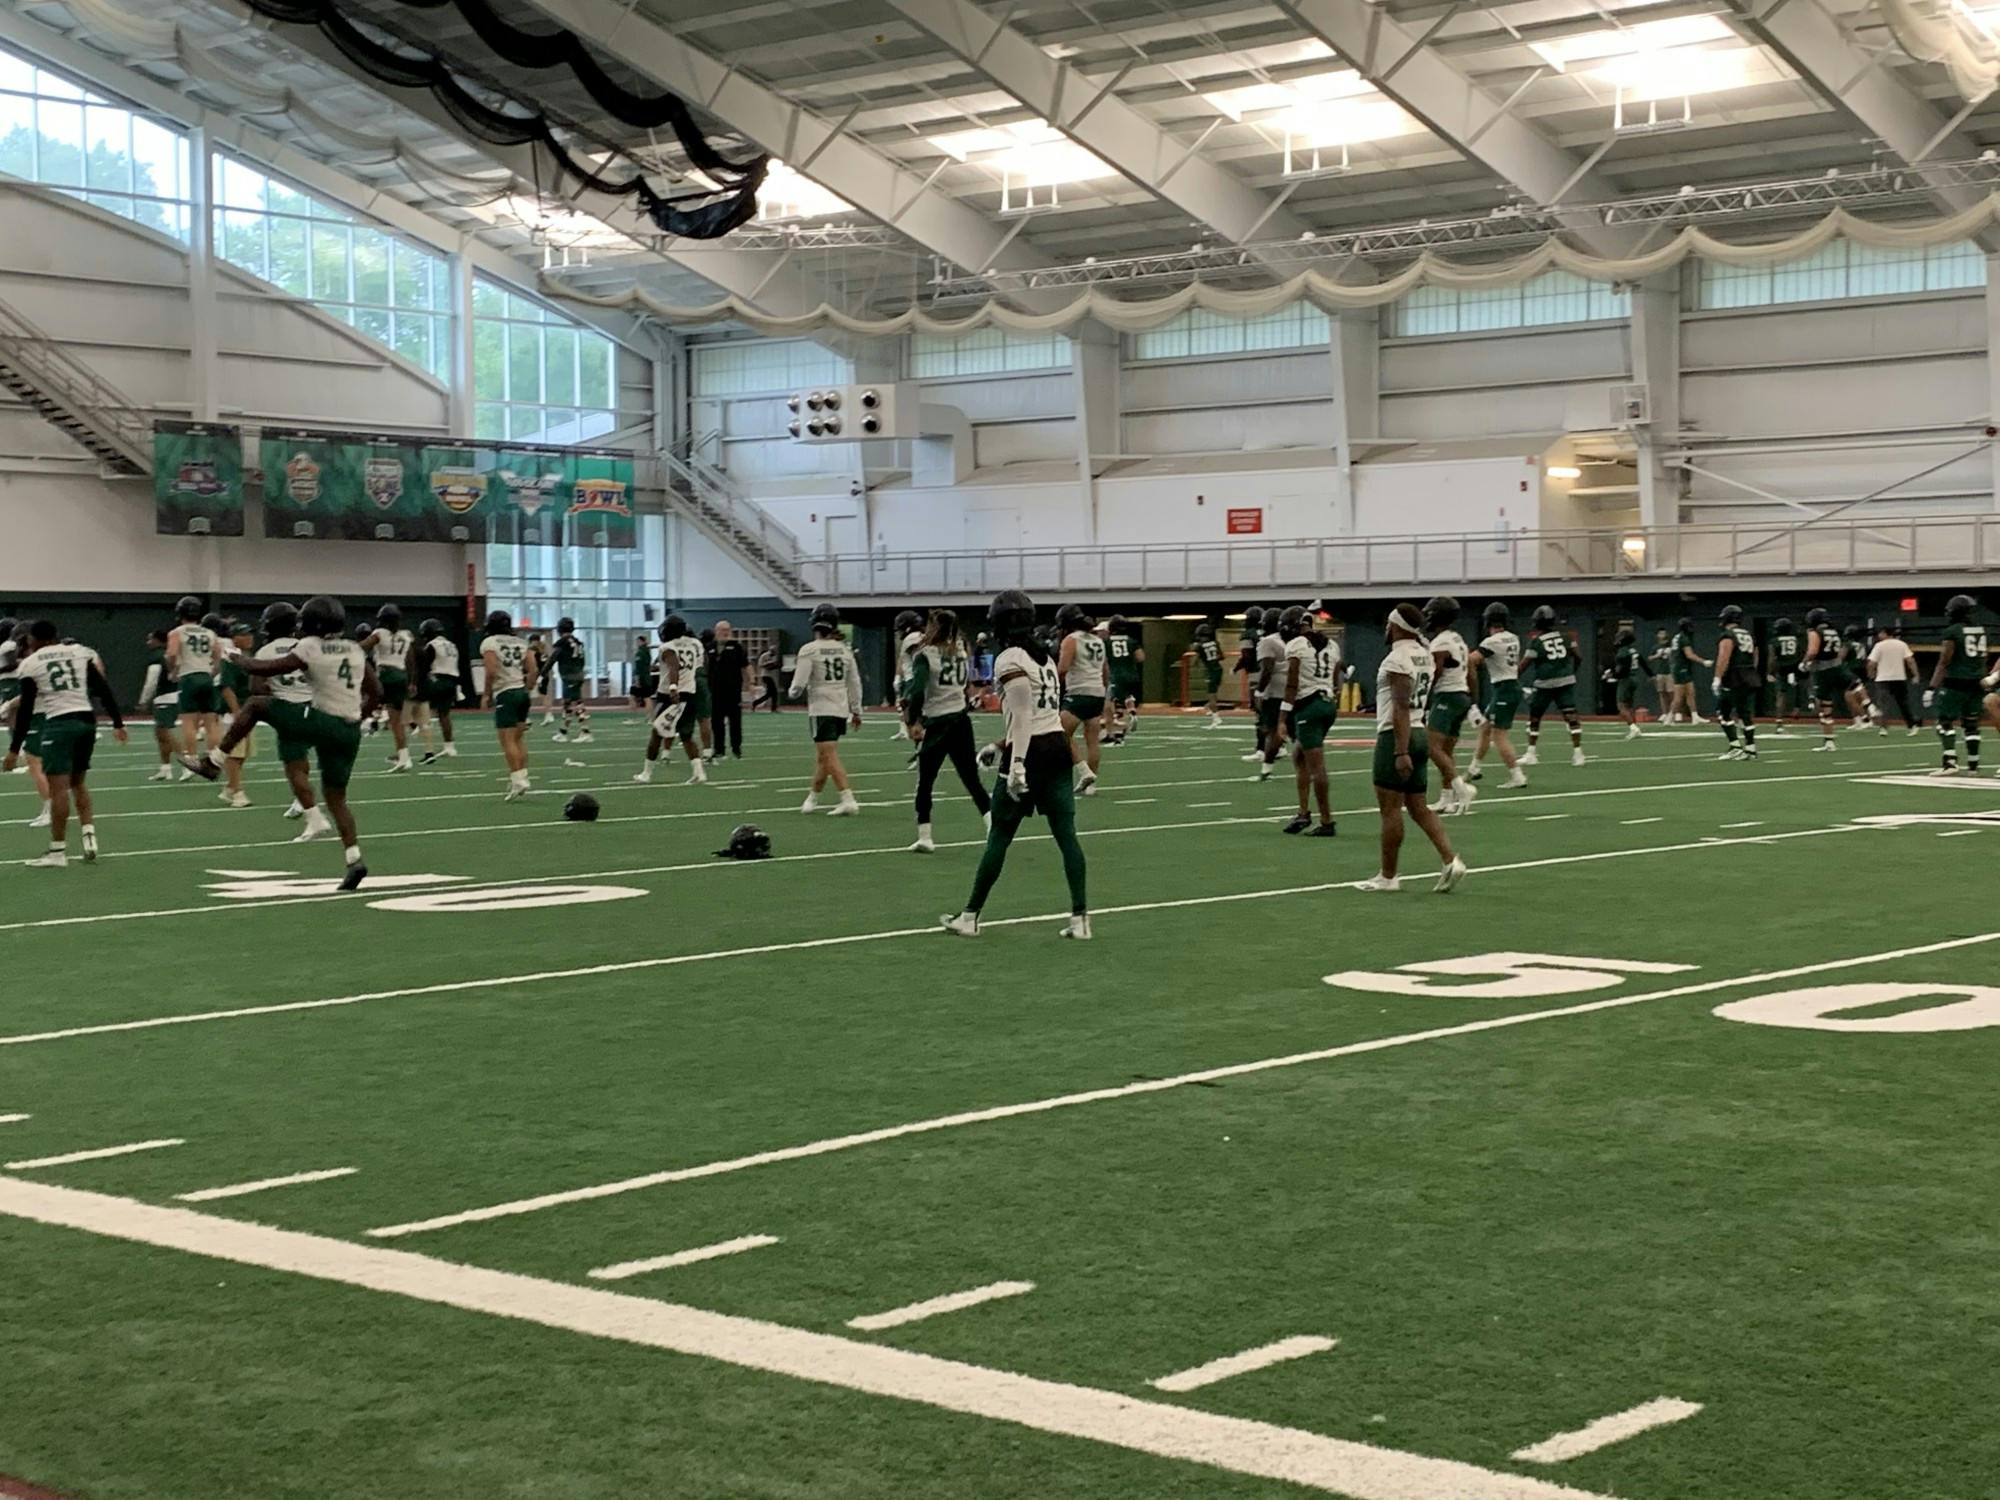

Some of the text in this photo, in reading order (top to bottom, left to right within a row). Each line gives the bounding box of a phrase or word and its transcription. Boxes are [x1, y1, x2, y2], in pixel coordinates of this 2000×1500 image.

[1111, 640, 1129, 658] 61
[1543, 638, 1567, 660] 55
[1781, 640, 1797, 656] 19
[1964, 635, 1988, 658] 64
[46, 660, 80, 692] 21
[337, 657, 355, 689] 4
[825, 658, 845, 681] 18
[939, 656, 967, 686] 20
[1322, 951, 2000, 1032] 50
